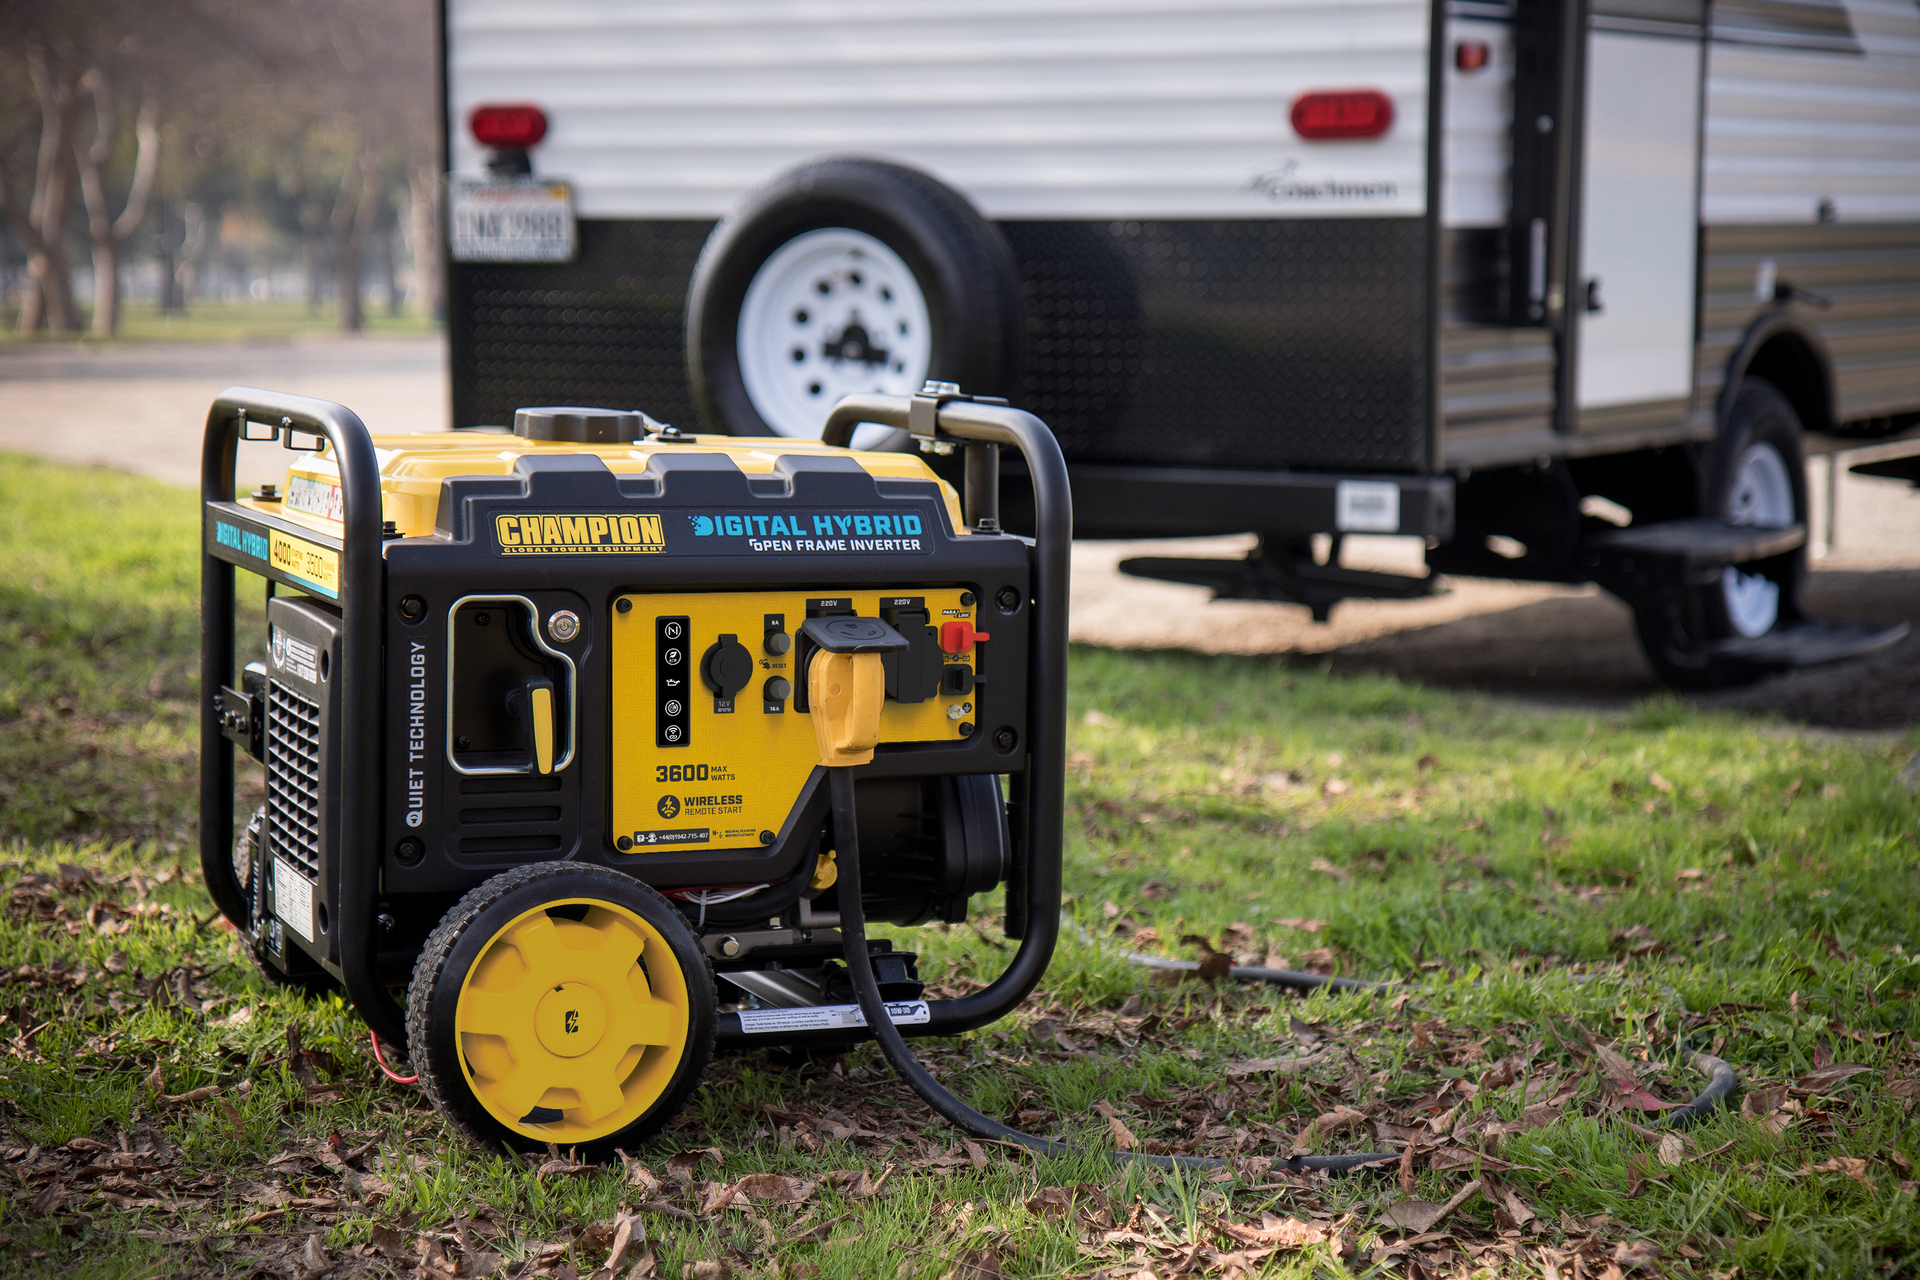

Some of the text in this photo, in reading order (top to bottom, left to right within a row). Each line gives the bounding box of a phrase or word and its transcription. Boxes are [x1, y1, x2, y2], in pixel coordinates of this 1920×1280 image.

[496, 514, 665, 546] CHAMPION
[688, 515, 922, 536] DIGITAL HYBRID
[216, 521, 268, 561] DIGITAL HYBRID
[749, 538, 921, 551] OPEN FRAME INVERTER
[273, 539, 292, 567] 4000
[305, 551, 324, 579] 3500
[405, 641, 426, 828] QUIET TECHNOLOGY
[656, 764, 708, 782] 3600
[711, 773, 736, 781] WATTS
[684, 795, 742, 806] WIRELESS
[684, 806, 742, 816] REMOTE START
[890, 1006, 911, 1015] 10W-30
